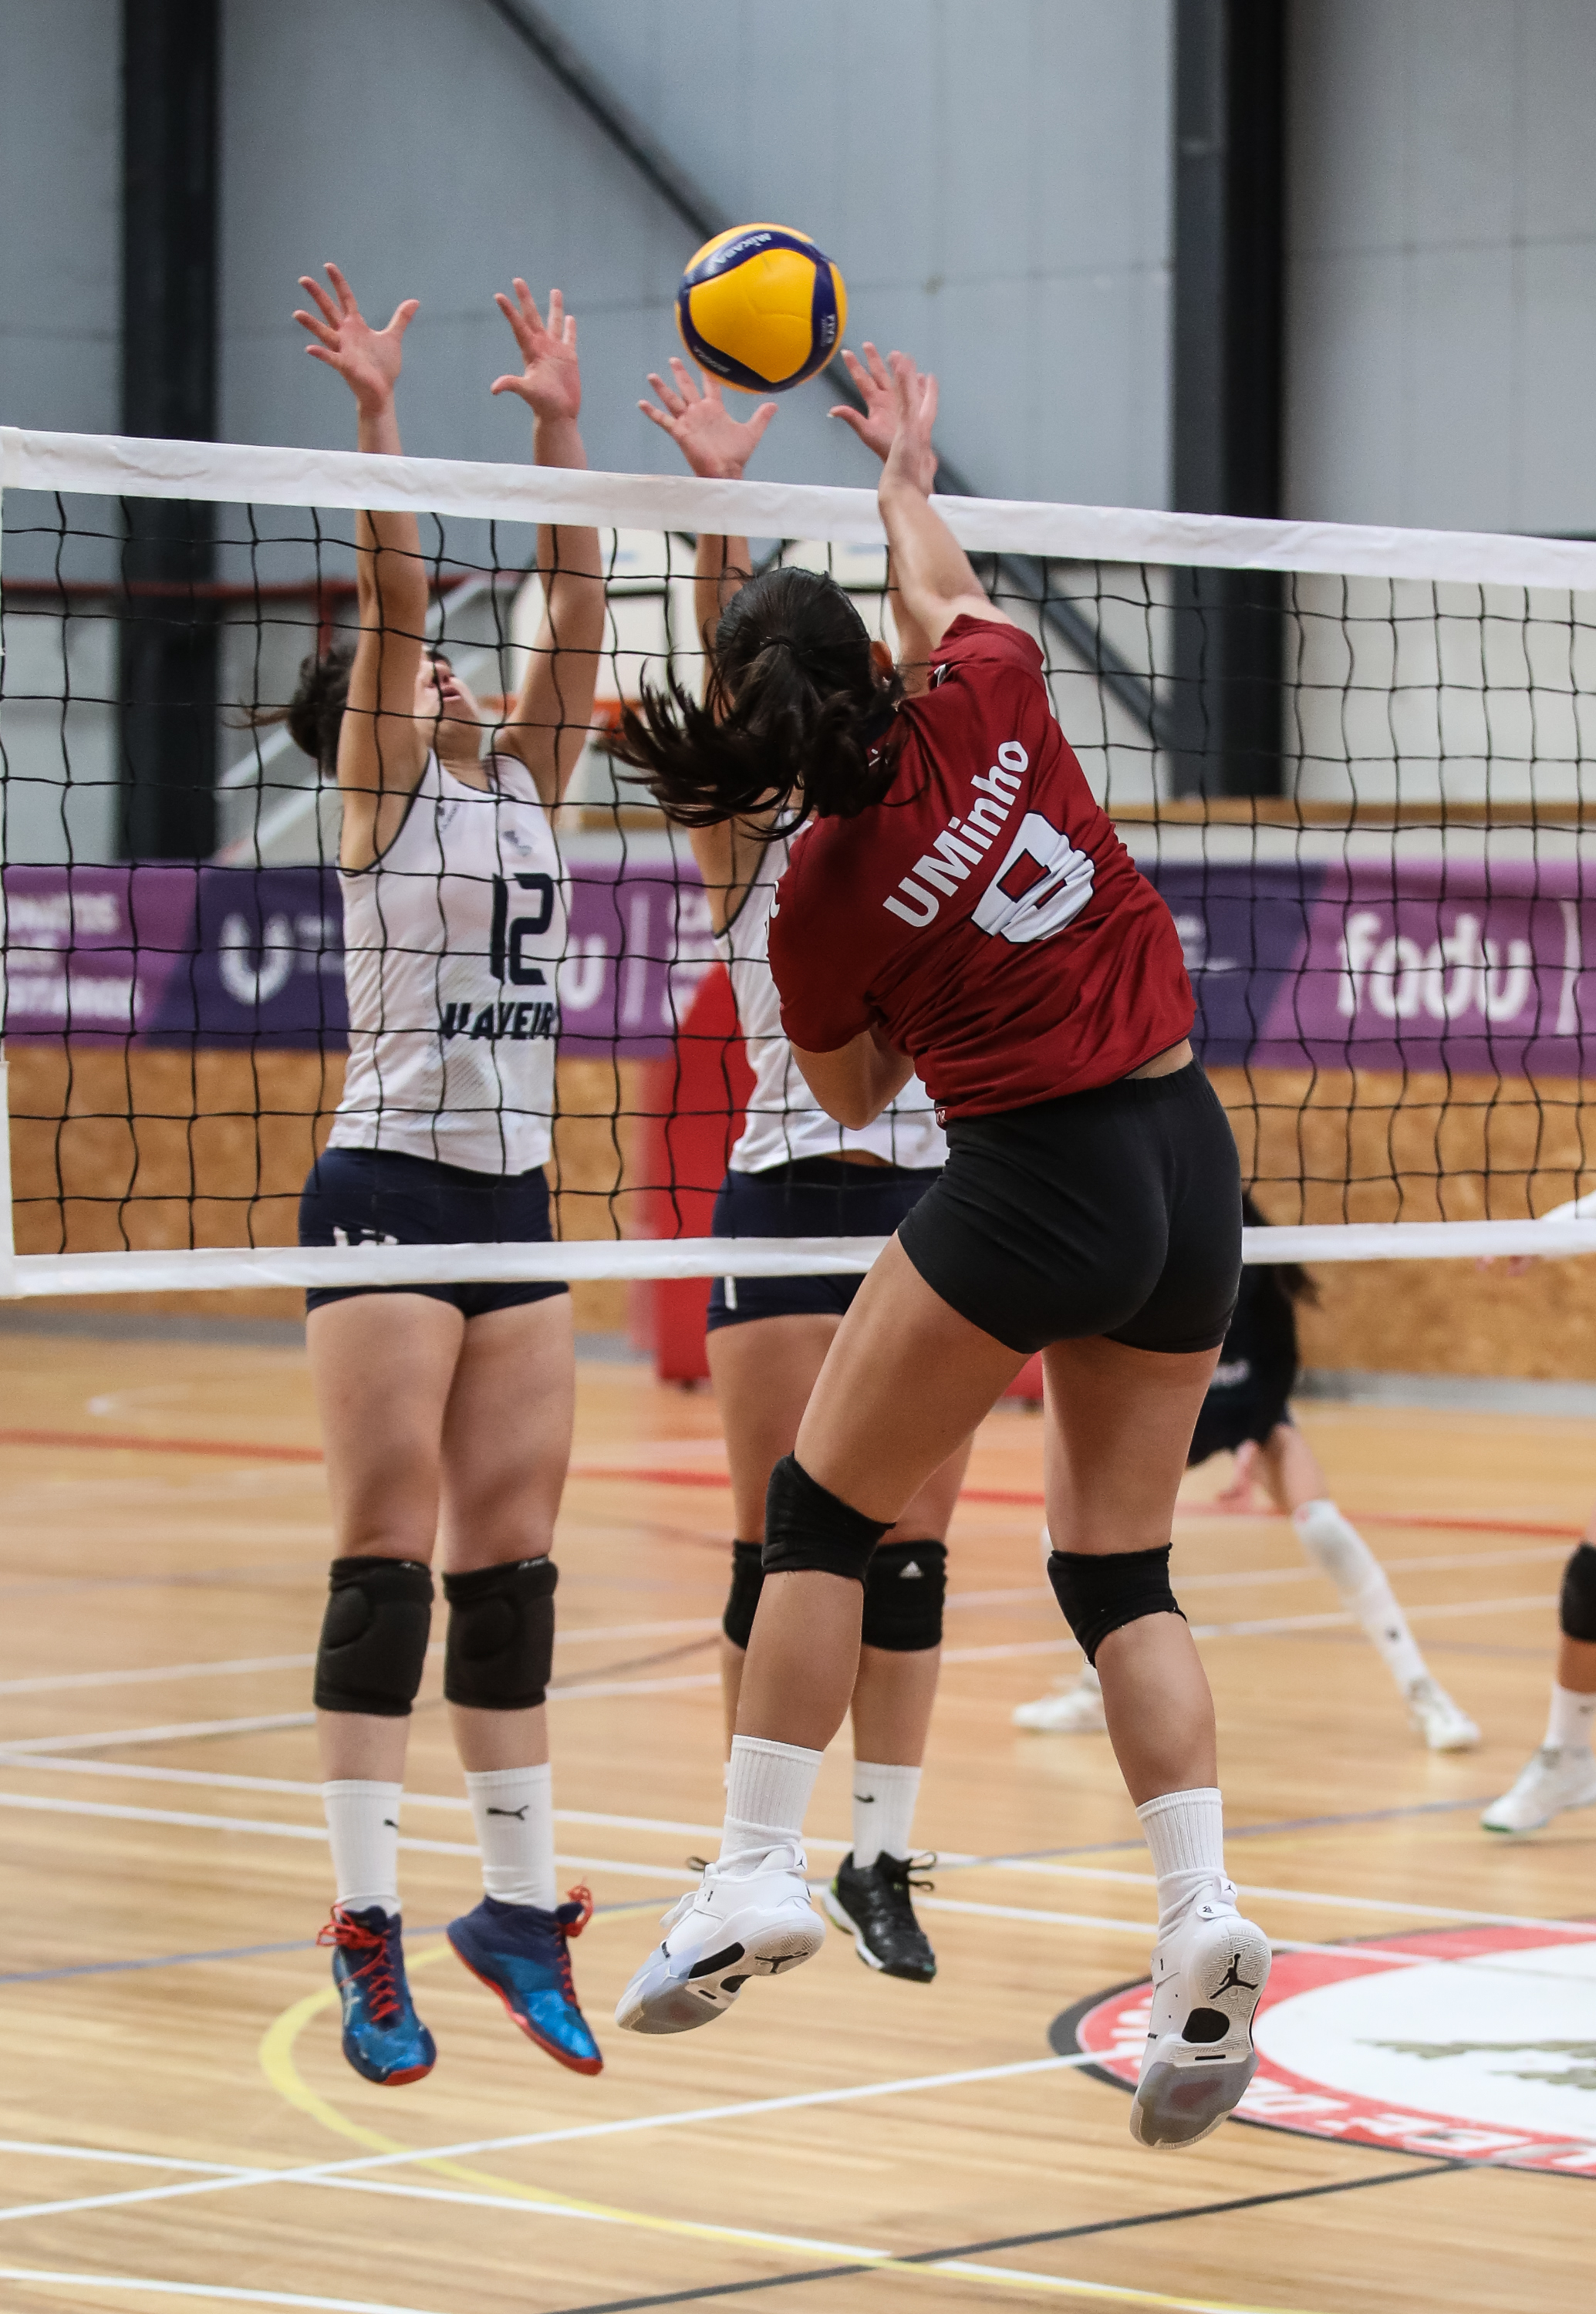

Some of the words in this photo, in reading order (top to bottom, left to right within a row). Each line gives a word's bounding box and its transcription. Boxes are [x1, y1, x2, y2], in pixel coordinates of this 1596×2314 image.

[882, 740, 1030, 928] UMinho
[489, 872, 555, 986] 12
[1337, 912, 1531, 1021] fadu
